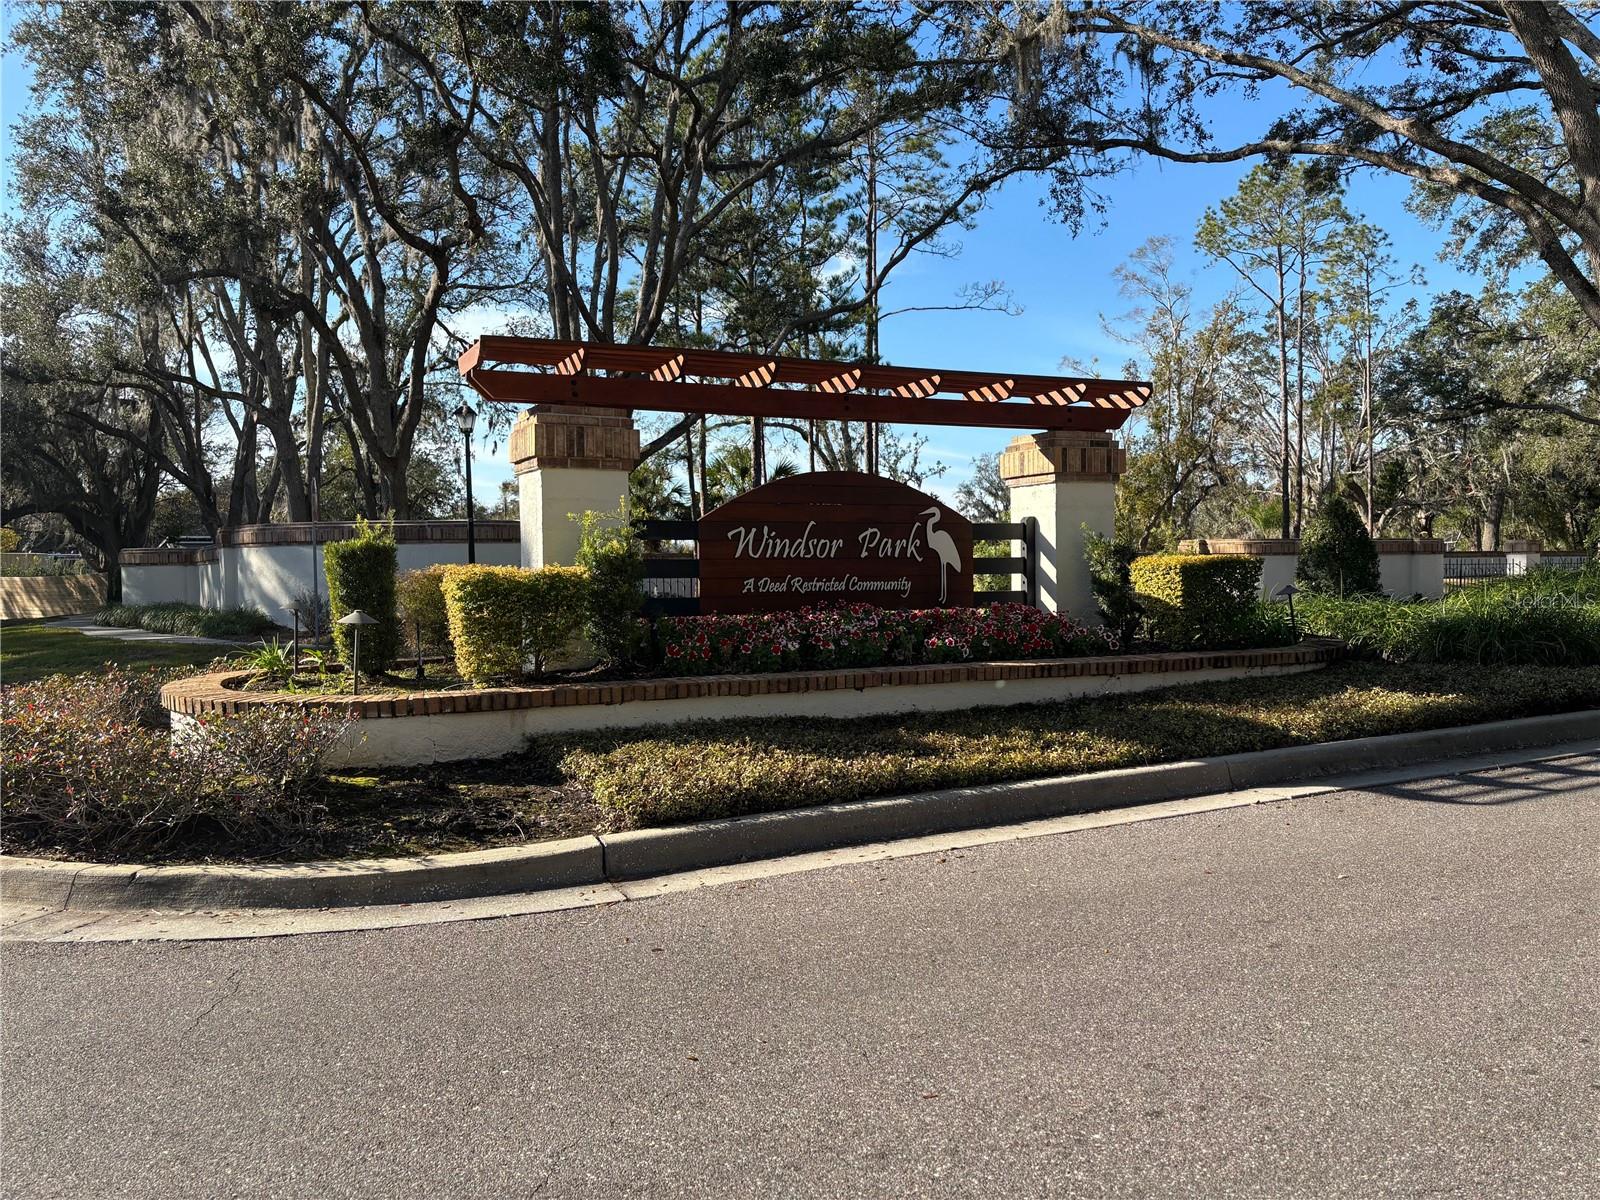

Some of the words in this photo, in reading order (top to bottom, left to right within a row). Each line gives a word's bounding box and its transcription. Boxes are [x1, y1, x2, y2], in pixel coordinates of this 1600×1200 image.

[727, 521, 843, 559] Windsor
[858, 522, 923, 562] Park
[742, 578, 755, 594] A
[758, 575, 791, 593] Deed
[792, 574, 849, 593] Restricted
[849, 576, 911, 598] Community
